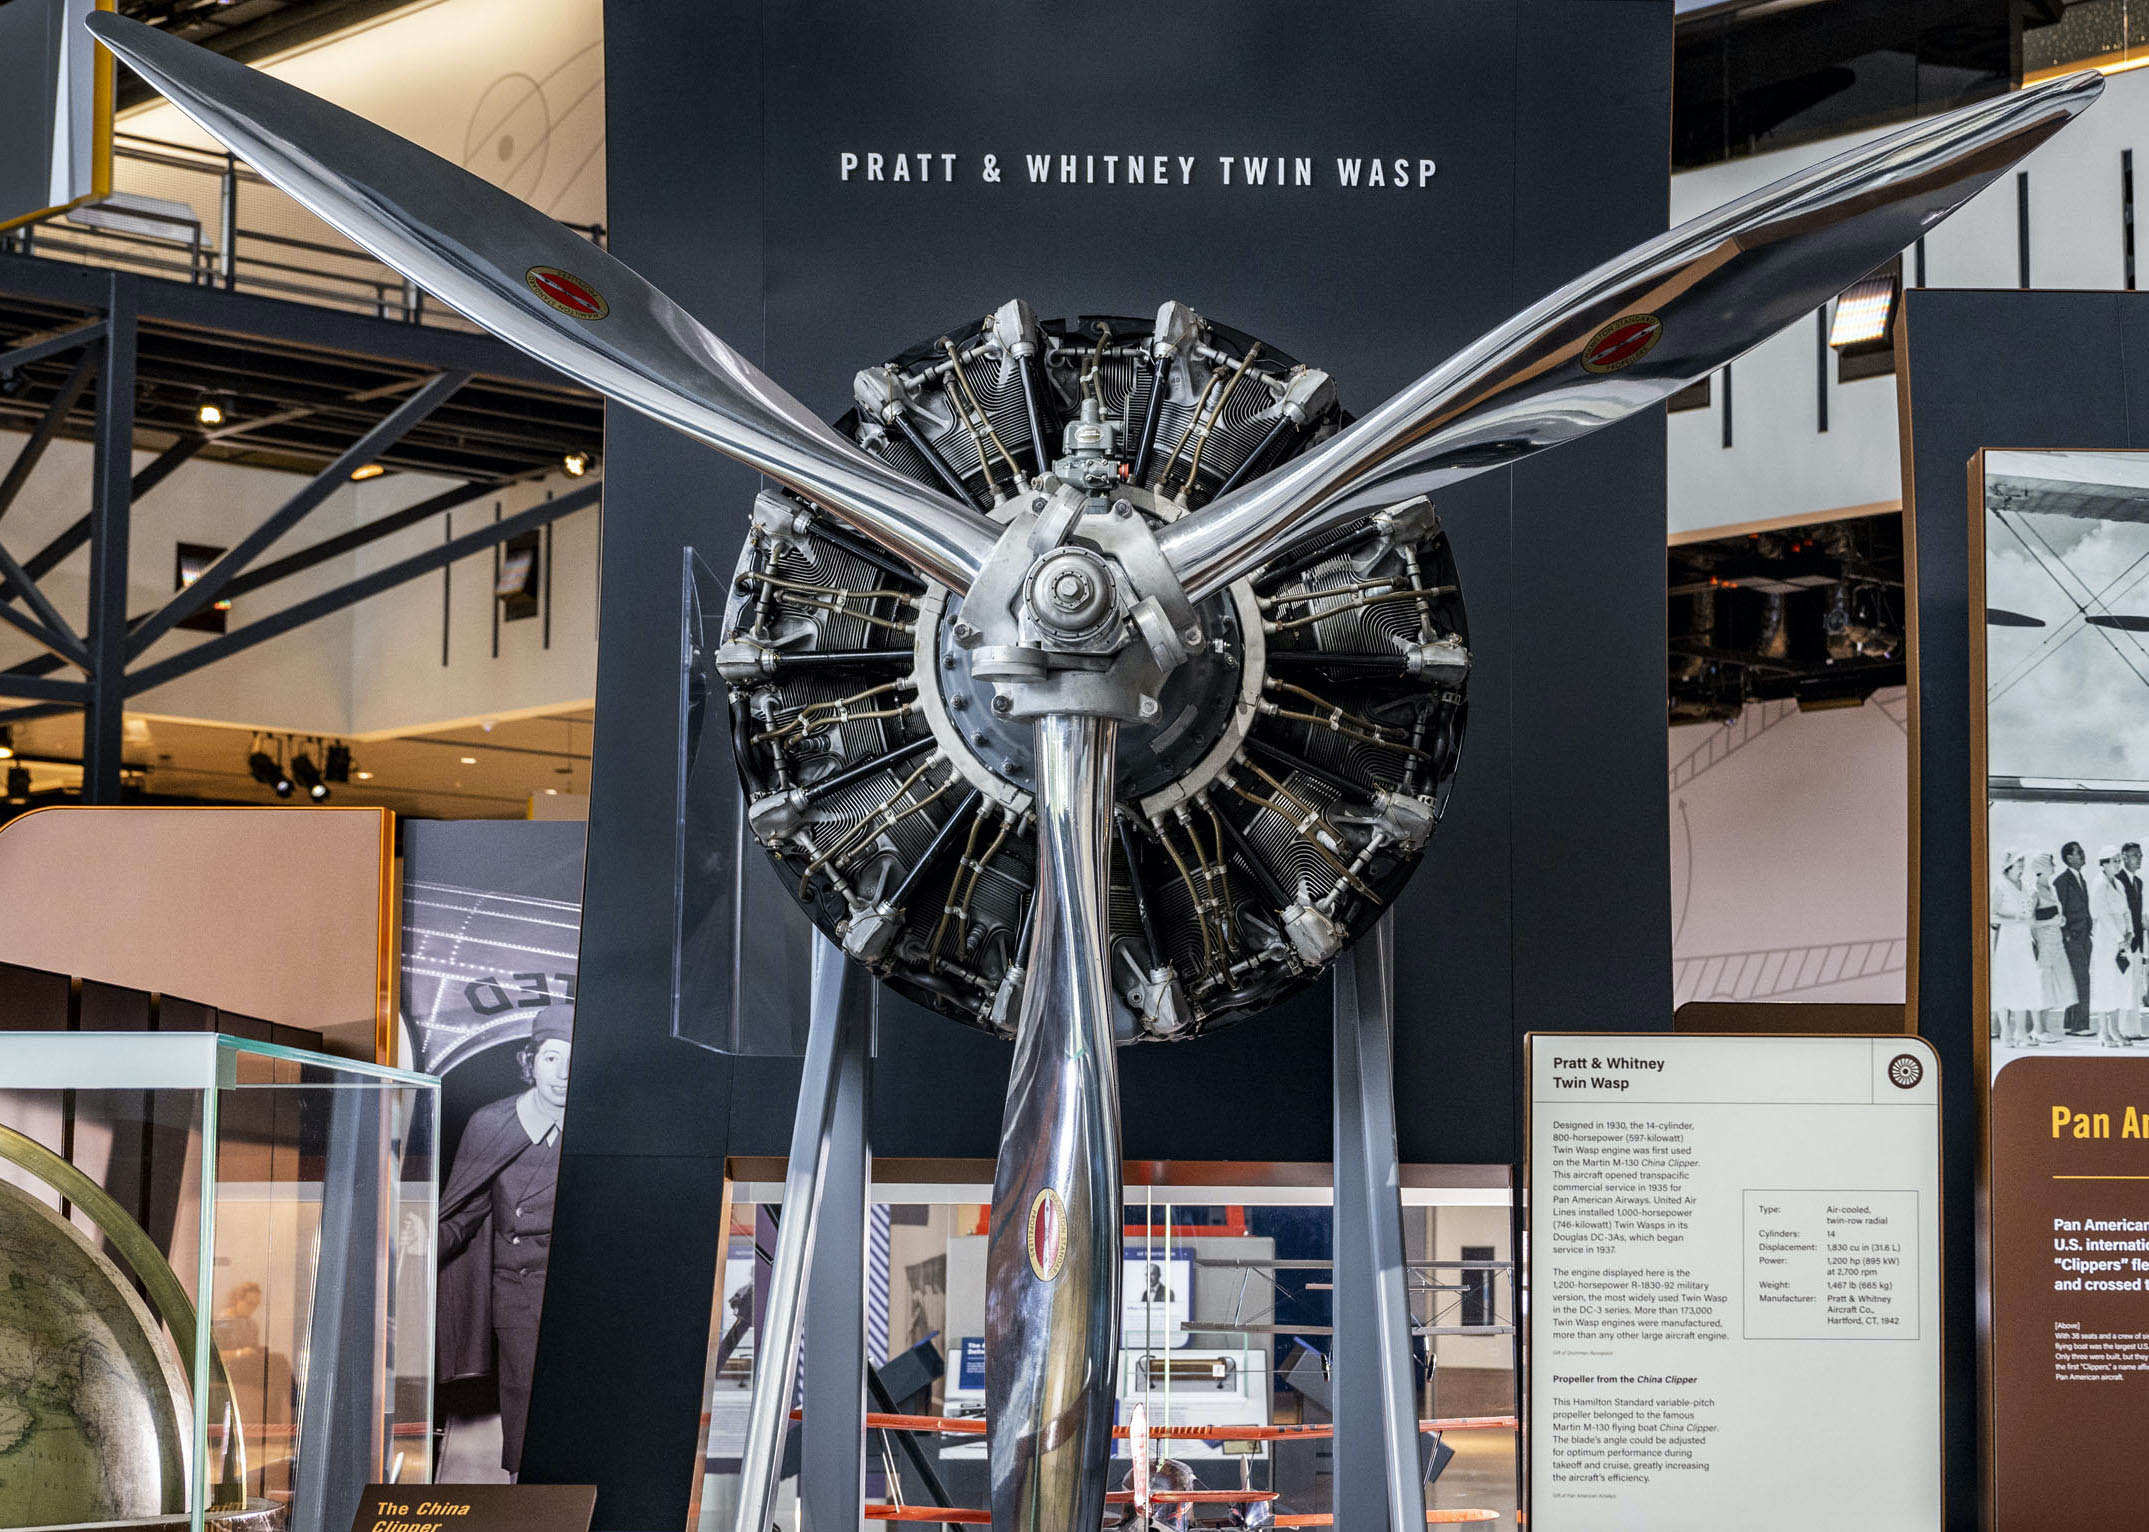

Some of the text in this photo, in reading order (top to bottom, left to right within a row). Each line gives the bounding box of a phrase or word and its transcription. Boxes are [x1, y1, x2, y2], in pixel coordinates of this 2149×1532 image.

[841, 153, 1436, 187] PRATT & WHITNEY TWIN WASP
[1554, 1057, 1664, 1072] Pratt & Whitney
[1553, 1076, 1629, 1092] Twin Wasp
[1553, 1120, 1594, 1130] Designed
[1630, 1121, 1644, 1130] the
[2052, 1106, 2109, 1138] Pan
[1552, 1132, 1684, 1143] 800-horsepower (597-kilowatt)
[1553, 1147, 1573, 1155] Twin
[1574, 1146, 1599, 1156] Wasp
[1601, 1146, 1630, 1156] engine
[1652, 1146, 1668, 1154] first
[1566, 1157, 1700, 1169] the Martin M-130 China Clipper.
[1553, 1169, 1690, 1180] This aircraft opened transpacific
[1553, 1183, 1668, 1192] commercial service 1935
[1553, 1195, 1569, 1204] Pan
[1572, 1196, 1613, 1204] American
[1654, 1196, 1682, 1204] United
[1684, 1196, 1696, 1204] Air
[1553, 1208, 1576, 1217] Lines
[1578, 1208, 1614, 1217] installed
[1553, 1220, 1666, 1231] (746-kilowatt) Twin Wasps
[2054, 1218, 2081, 1231] Pan
[1553, 1232, 1588, 1243] Douglas
[1628, 1233, 1655, 1242] which
[1657, 1233, 1684, 1244] began
[1553, 1245, 1584, 1254] service
[2054, 1238, 2083, 1251] U.S.
[1553, 1268, 1690, 1278] The engine displayed here the
[1632, 1281, 1674, 1289] R-1830-92
[1677, 1280, 1709, 1291] military
[2054, 1278, 2082, 1290] and
[2084, 1278, 2141, 1291] crossed
[1553, 1293, 1728, 1304] version, the most widely used Twin Wasp
[1563, 1306, 1577, 1314] the
[1580, 1306, 1602, 1314] DC-3
[1634, 1306, 1656, 1314] More
[1658, 1306, 1678, 1314] than
[1553, 1318, 1573, 1327] Twin
[1575, 1318, 1599, 1328] Wasp
[1602, 1318, 1635, 1328] engines
[1577, 1331, 1596, 1339] than
[1616, 1331, 1639, 1339] other
[1642, 1331, 1663, 1341] large
[1665, 1331, 1695, 1340] aircraft
[1697, 1331, 1729, 1342] engine.
[1553, 1375, 1594, 1384] Propeller
[1597, 1375, 1617, 1383] from
[1620, 1375, 1634, 1383] the
[1665, 1376, 1698, 1385] Clipper
[1553, 1398, 1715, 1408] This Hamilton Standard variable-pitch
[1553, 1410, 1694, 1421] propeller belonged the famous
[1553, 1423, 1719, 1434] Martin M-130 flying boat China Clipper.
[1553, 1435, 1568, 1444] The
[1603, 1436, 1628, 1446] angle
[1629, 1436, 1653, 1444] could
[1669, 1435, 1706, 1446] adjusted
[1566, 1448, 1692, 1459] optimum performance during
[1553, 1460, 1582, 1469] takeoff
[1584, 1461, 1600, 1469] and
[1633, 1461, 1663, 1471] greatly
[1665, 1461, 1710, 1472] increasing
[1553, 1473, 1566, 1482] the
[1608, 1474, 1650, 1484] efficiency.
[378, 1502, 471, 1516] The China
